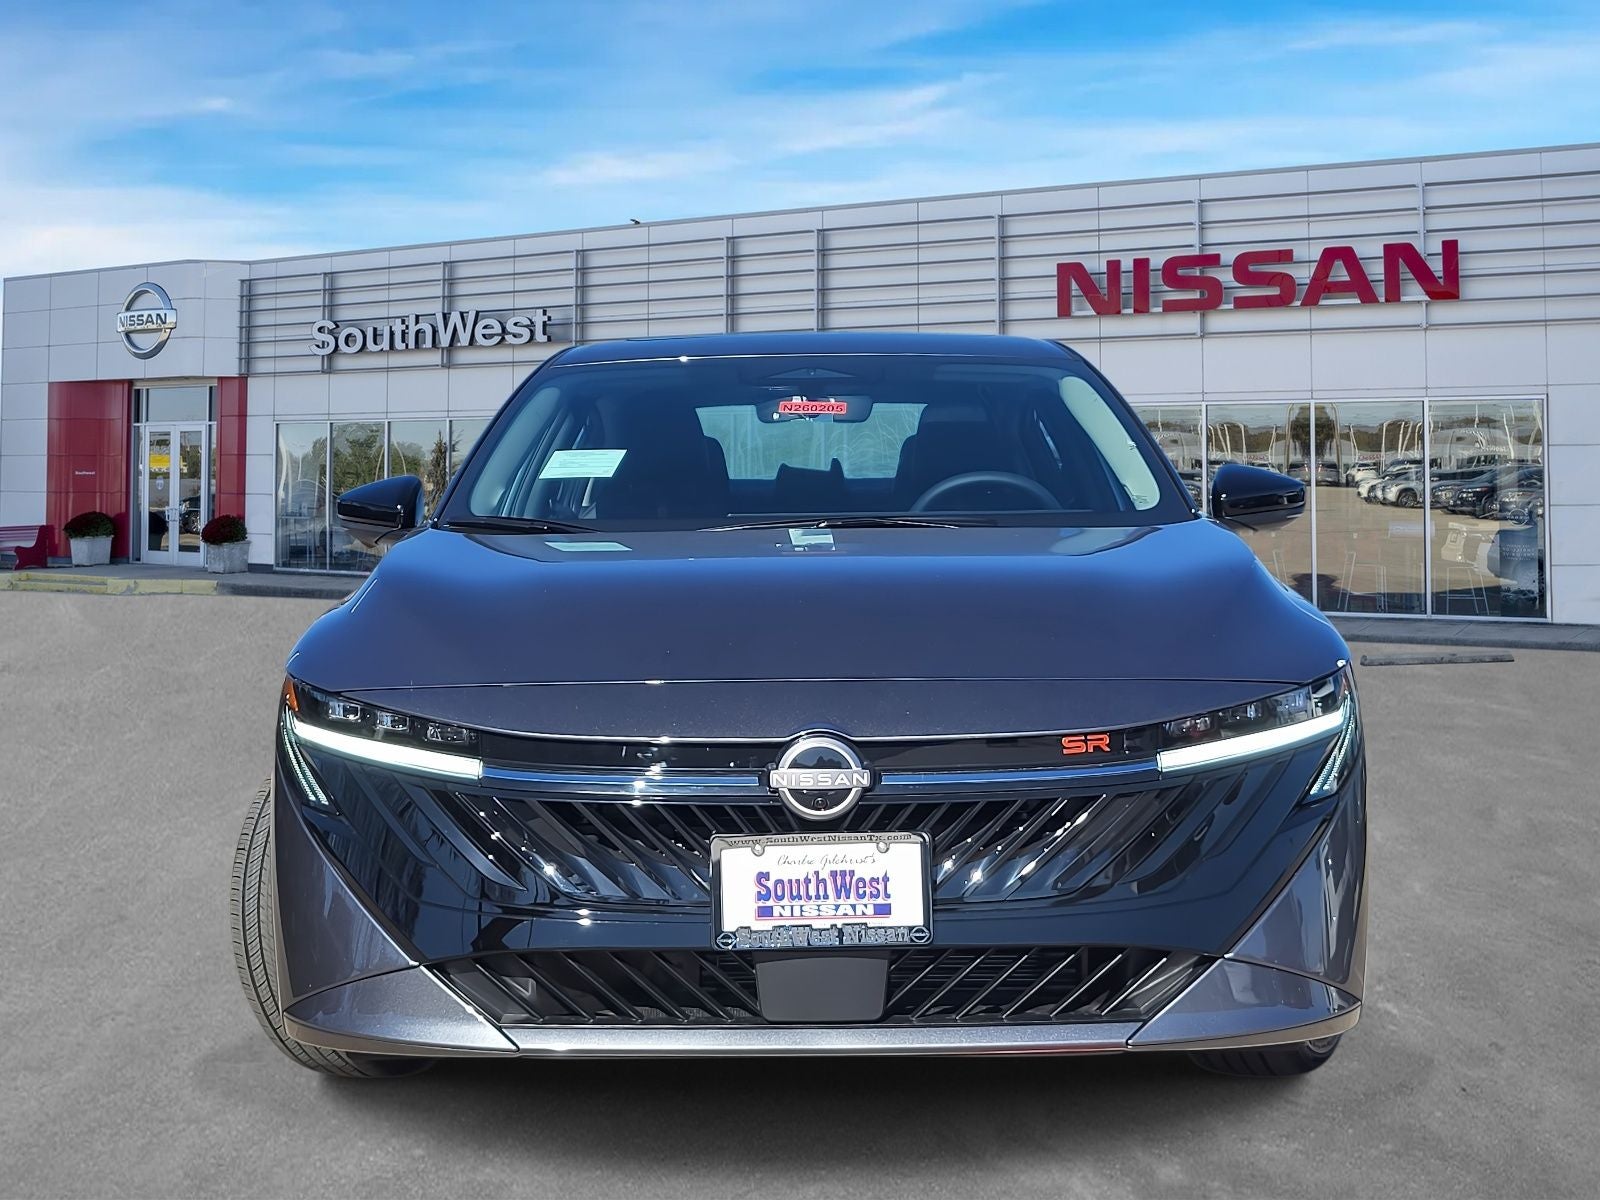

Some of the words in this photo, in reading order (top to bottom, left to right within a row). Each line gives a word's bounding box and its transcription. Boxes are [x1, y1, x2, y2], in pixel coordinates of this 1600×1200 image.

[1056, 239, 1460, 318] NISSAN
[118, 312, 168, 328] NISSAN
[309, 308, 552, 356] SouthWest
[783, 404, 844, 412] N260205
[1062, 733, 1111, 754] SR
[772, 772, 868, 787] NISSAN
[777, 854, 815, 866] Charlie
[755, 869, 891, 903] SouthWest
[773, 903, 875, 917] NISSAN
[736, 925, 840, 947] SouthWest
[842, 923, 911, 944] Nissan
